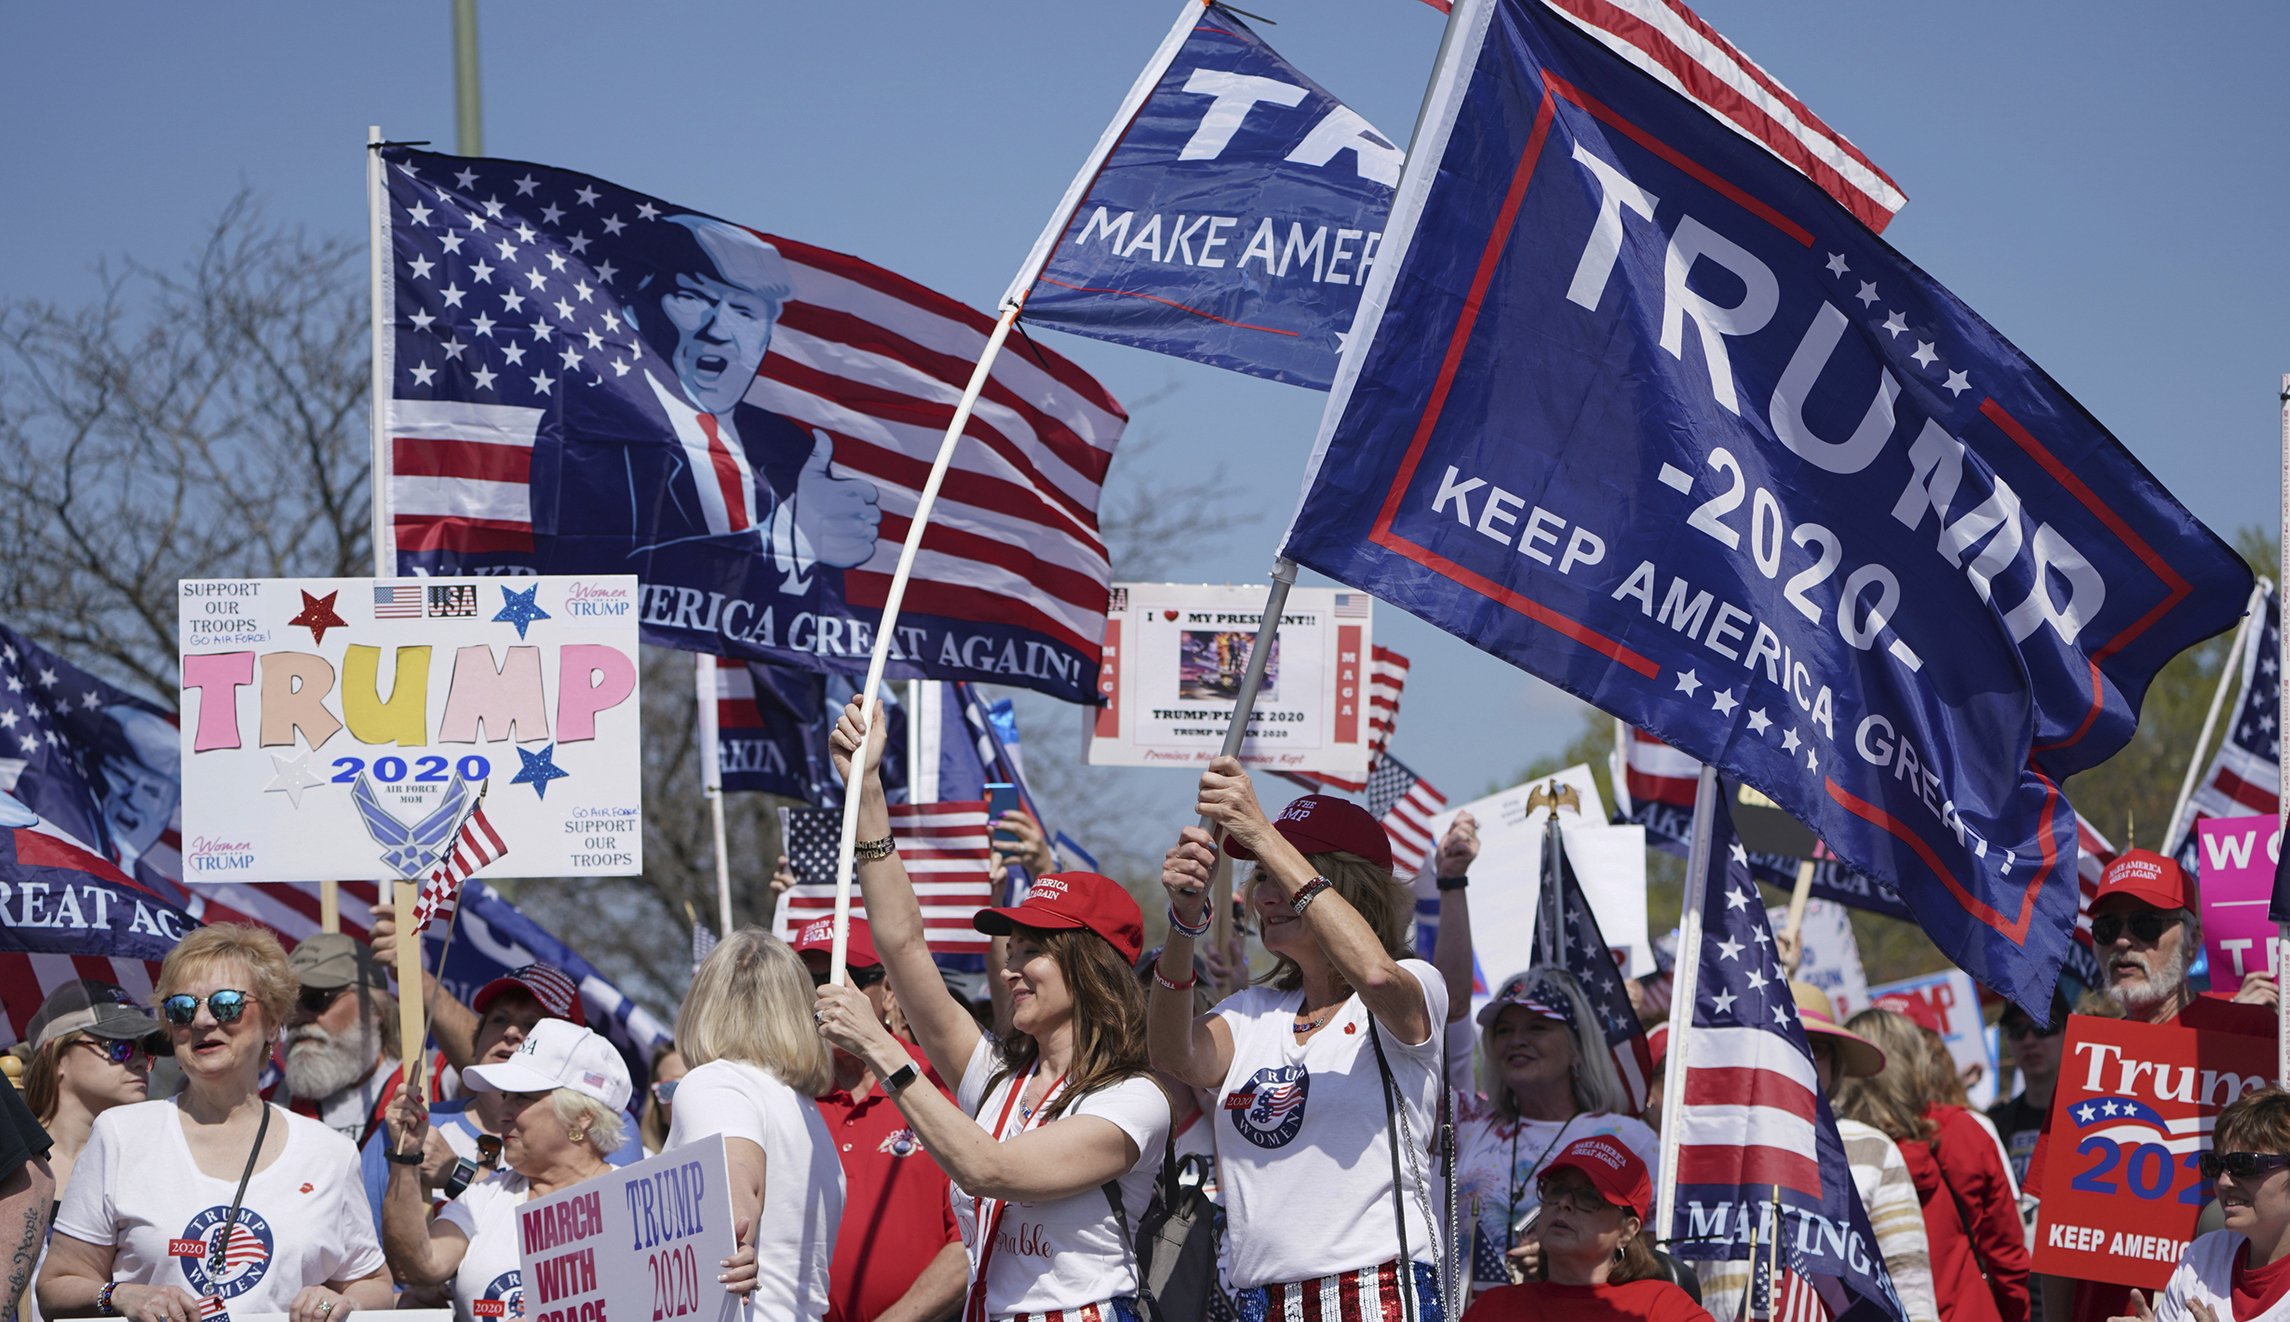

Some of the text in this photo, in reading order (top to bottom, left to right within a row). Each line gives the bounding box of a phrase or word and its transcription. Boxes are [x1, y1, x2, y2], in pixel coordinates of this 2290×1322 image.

[1075, 206, 1238, 268] MAKE
[1565, 143, 2106, 646] TRUMP
[183, 583, 261, 596] SUPPORT
[569, 581, 628, 598] Women
[205, 601, 240, 615] OUR
[428, 585, 478, 617] USA
[571, 602, 630, 616] TRUMP
[1430, 464, 1606, 576] KEEP
[1611, 559, 1834, 741] AMERICA
[189, 619, 257, 633] TROOPS
[1147, 612, 1316, 626] I MY PRESIENT!!
[189, 634, 211, 646] GO
[213, 634, 233, 645] AIR
[938, 632, 1080, 686] AGAIN!
[1341, 652, 1357, 716] MAGA
[182, 643, 637, 753] TRUMP
[1153, 709, 1305, 722] TRUMP/PECE 2020
[1173, 728, 1213, 736] TRUMP
[1263, 730, 1288, 738] 2020
[331, 755, 491, 783] 2020
[405, 785, 438, 793] FORCE
[400, 796, 423, 804] MOM
[1297, 800, 1317, 809] THE
[572, 806, 589, 818] GO
[590, 807, 611, 817] AIR
[564, 819, 636, 833] SUPPORT
[192, 836, 253, 852] Women
[584, 837, 616, 849] OUR
[195, 855, 255, 870] TRUMP
[570, 853, 632, 867] TROOPS
[2126, 860, 2162, 874] AMERICA
[2131, 869, 2157, 880] AGAIN
[802, 927, 850, 946] SWAM
[2075, 1041, 2280, 1107] Trum
[1227, 1096, 1252, 1106] 2020
[1240, 1111, 1300, 1146] WOMEN
[1594, 1142, 1627, 1168] AMERICA
[1594, 1151, 1621, 1171] AGAIN
[625, 1160, 704, 1251] TRUMP
[190, 1208, 266, 1232] TRUMP
[522, 1190, 603, 1255] MARCH
[1684, 1200, 1871, 1277] MAKING
[2048, 1223, 2105, 1252] KEEP
[171, 1242, 204, 1254] 2020
[189, 1266, 264, 1298] WOMEN
[535, 1247, 597, 1304] WITH
[648, 1243, 698, 1322] 2020
[475, 1303, 503, 1314] 2020
